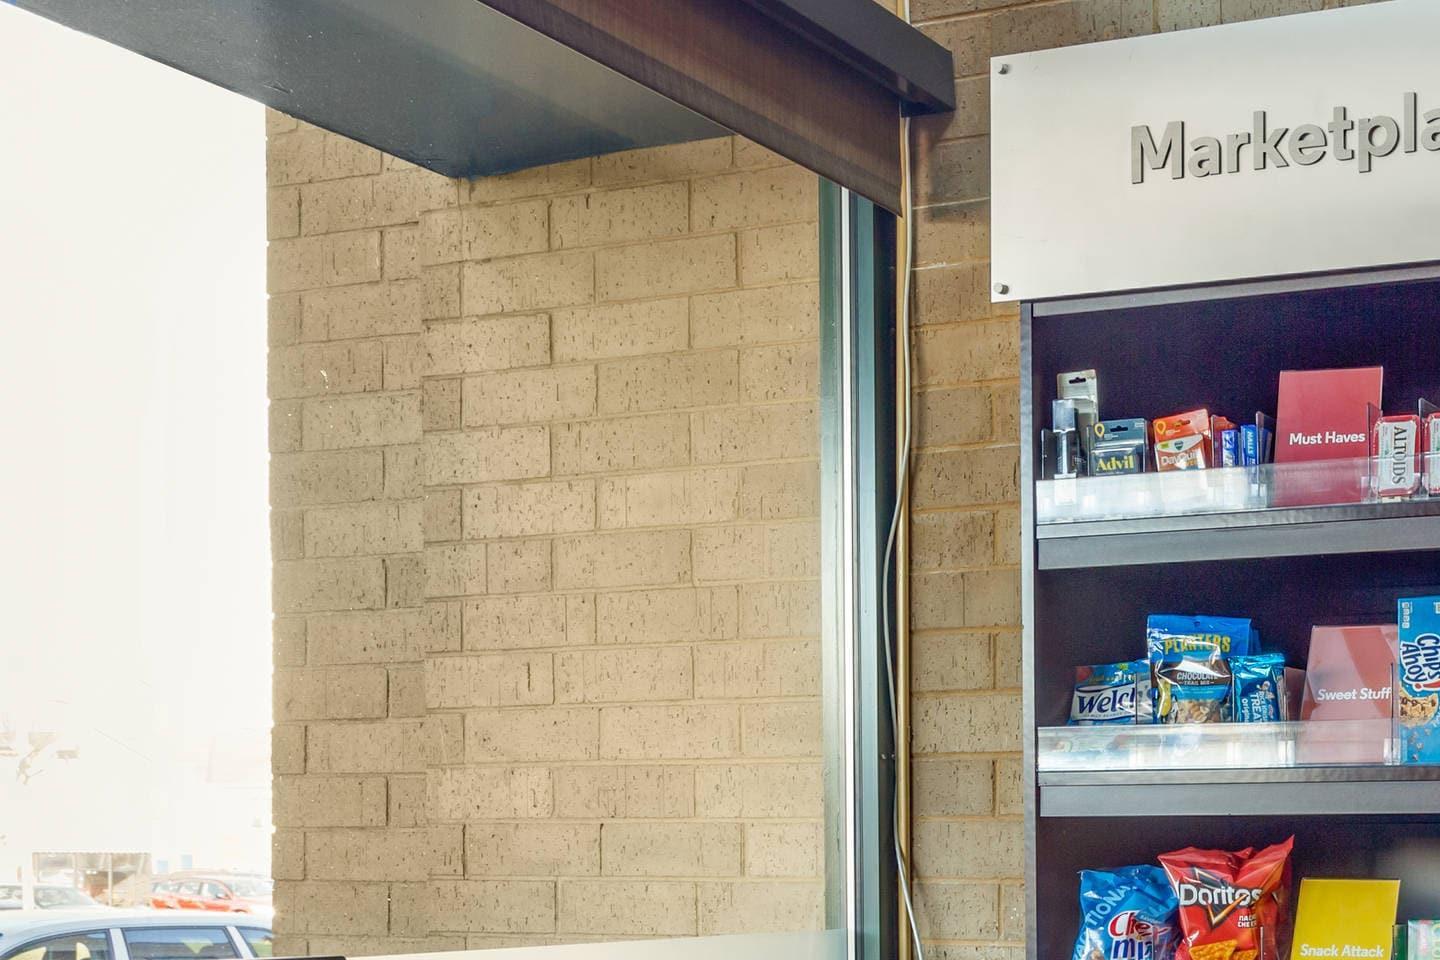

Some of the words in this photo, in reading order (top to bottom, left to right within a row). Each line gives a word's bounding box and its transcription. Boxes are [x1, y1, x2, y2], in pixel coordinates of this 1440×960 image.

[1289, 432, 1322, 446] Must
[1325, 431, 1366, 444] Haves
[1096, 454, 1135, 471] Advil
[1392, 426, 1408, 485] ALTOIDS
[1317, 688, 1356, 701] Sweet
[1360, 687, 1393, 701] Stuff
[1179, 883, 1263, 907] Doritos
[1300, 943, 1338, 958] Snack
[1341, 944, 1384, 958] Attack
